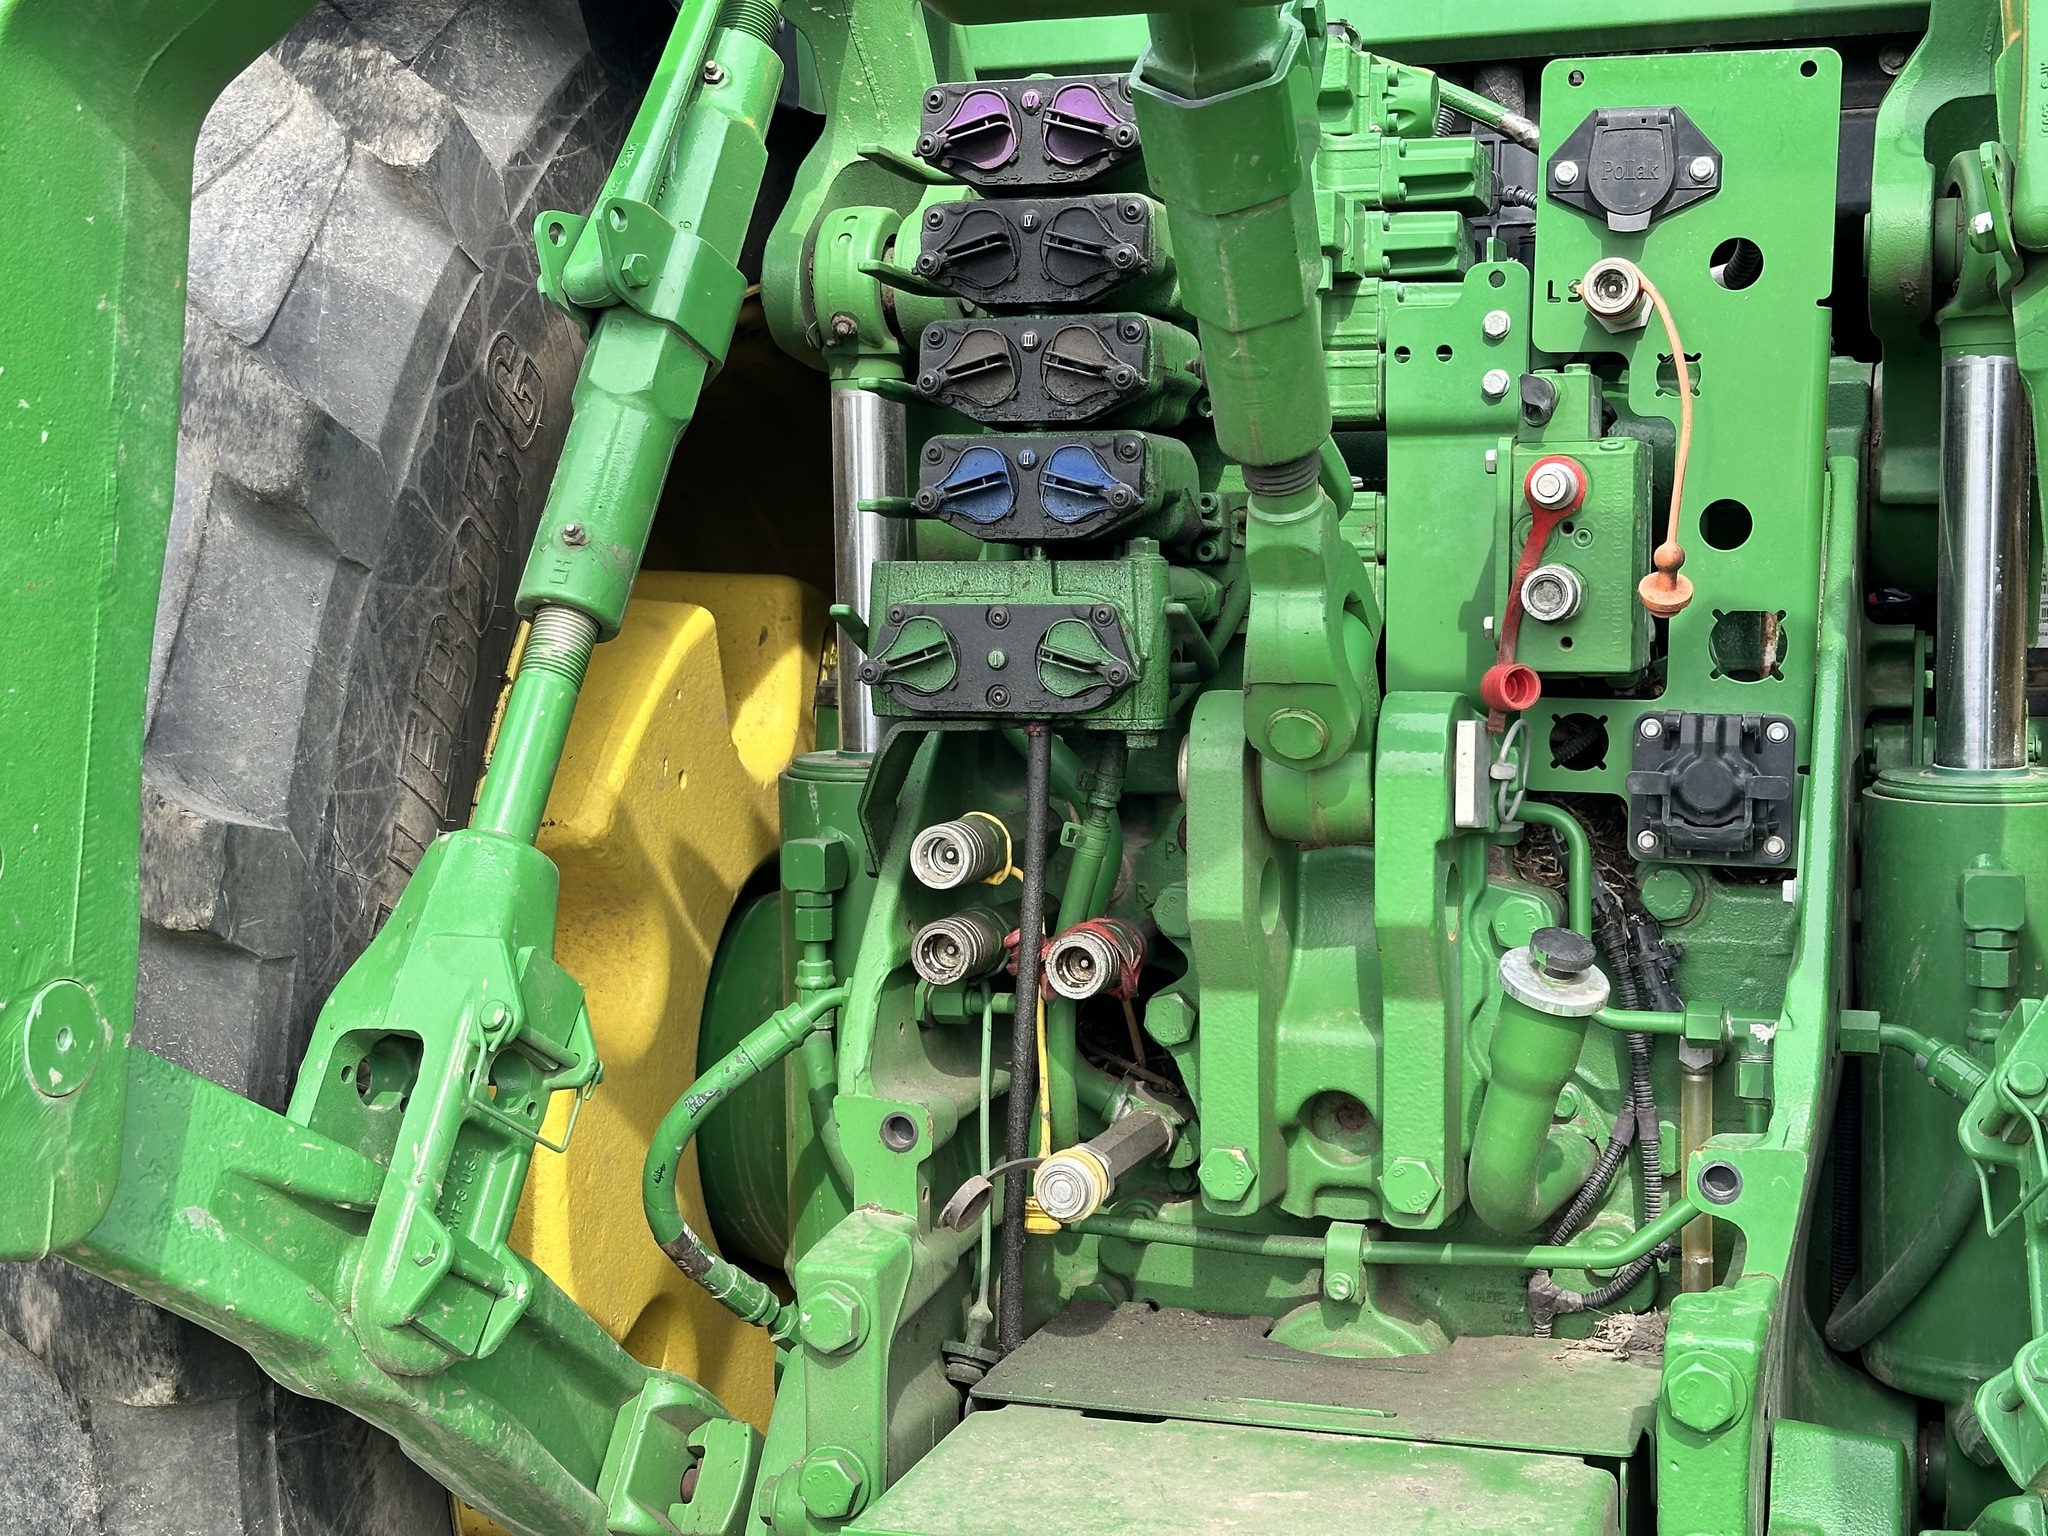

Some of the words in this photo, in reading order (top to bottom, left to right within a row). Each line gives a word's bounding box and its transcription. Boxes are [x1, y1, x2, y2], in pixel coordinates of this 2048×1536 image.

[1024, 95, 1035, 107] V
[1601, 158, 1660, 181] Pollak
[1023, 214, 1034, 228] IV
[1547, 279, 1583, 303] LS
[1023, 333, 1035, 347] III
[549, 558, 573, 584] LH
[1136, 882, 1150, 903] R
